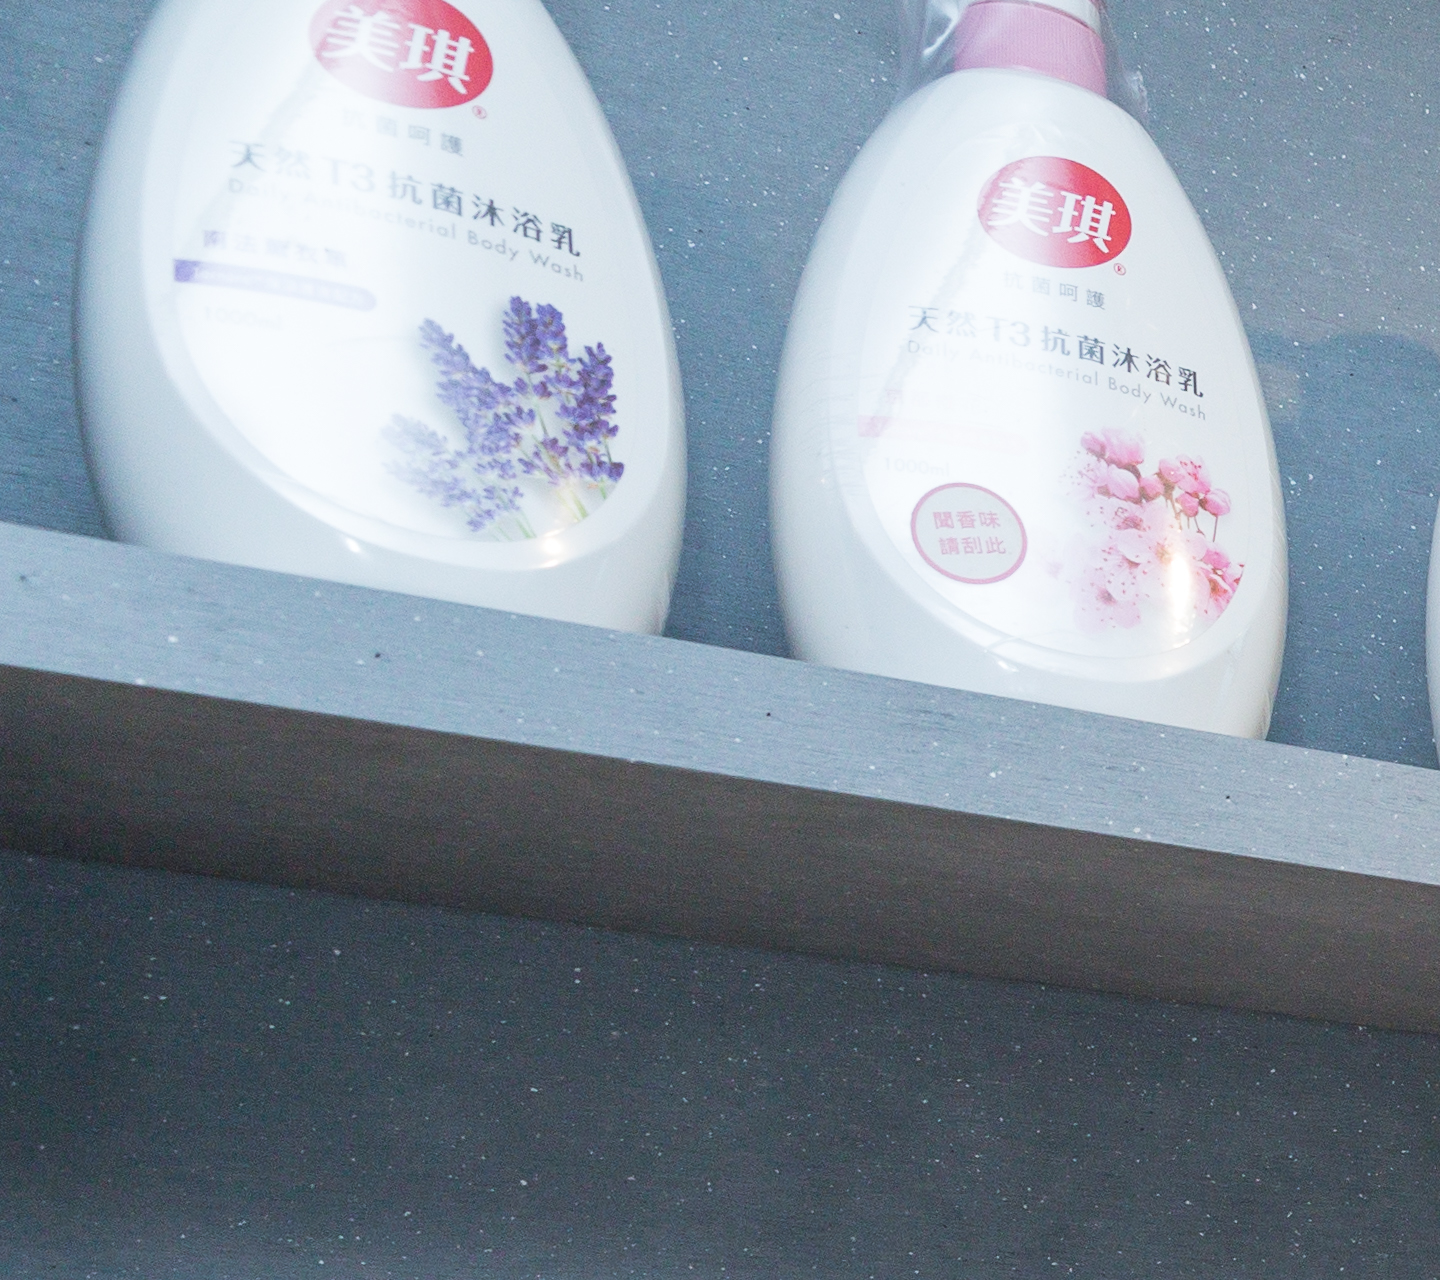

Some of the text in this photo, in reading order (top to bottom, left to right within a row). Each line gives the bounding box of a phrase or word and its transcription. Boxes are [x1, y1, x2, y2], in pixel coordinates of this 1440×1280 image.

[321, 4, 477, 94] 美琪
[987, 176, 1117, 254] 美琪
[1108, 376, 1207, 421] Body Wash
[933, 510, 1002, 530] 聞香味
